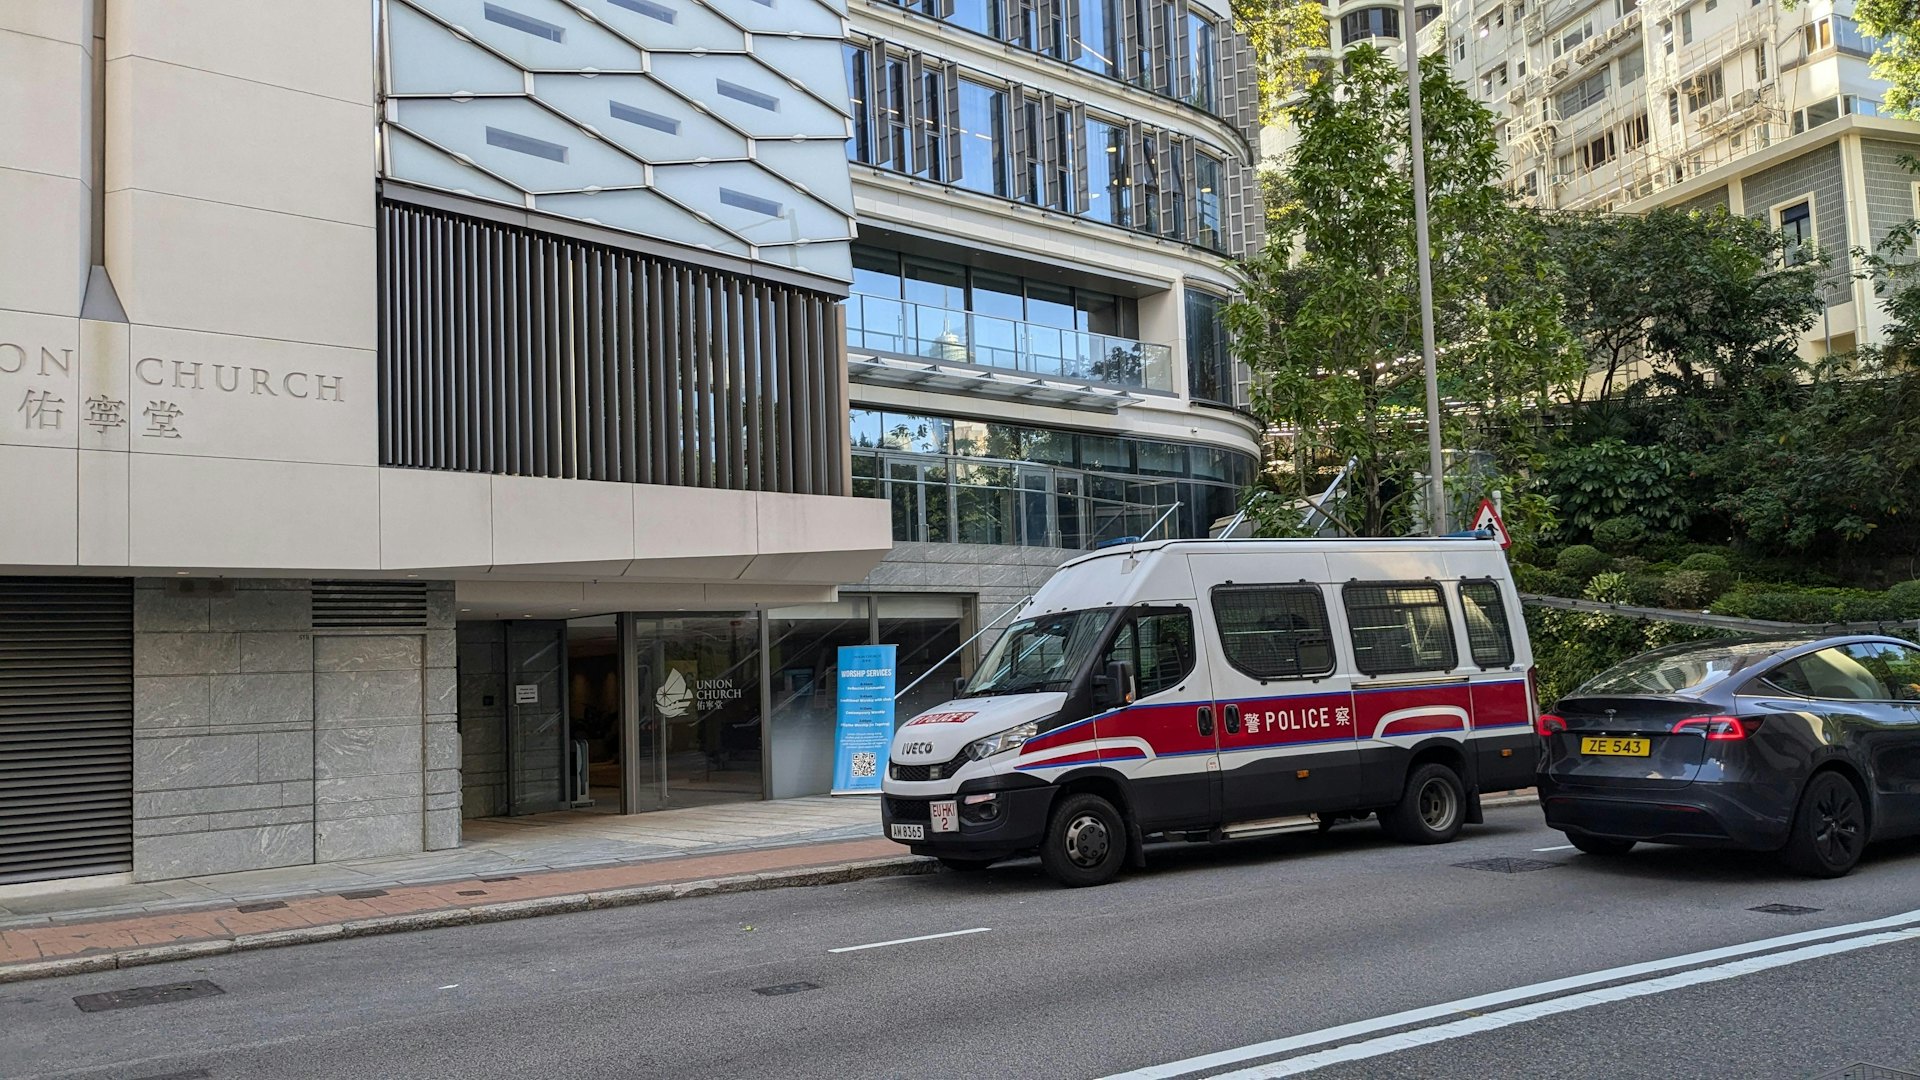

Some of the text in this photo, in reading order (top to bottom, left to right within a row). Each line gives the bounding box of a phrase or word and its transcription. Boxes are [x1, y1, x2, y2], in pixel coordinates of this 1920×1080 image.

[135, 357, 345, 402] CHURCH
[18, 389, 184, 439] 佑寧堂
[841, 669, 892, 678] WORSHIP SERVICES
[696, 679, 733, 690] UNION
[696, 689, 742, 699] CHURCH
[1244, 706, 1350, 734] 警 POLICE 察
[902, 742, 933, 755] IVECO
[1589, 740, 1641, 753] ZE 543
[941, 817, 949, 830] 2
[902, 826, 922, 838] 8365
